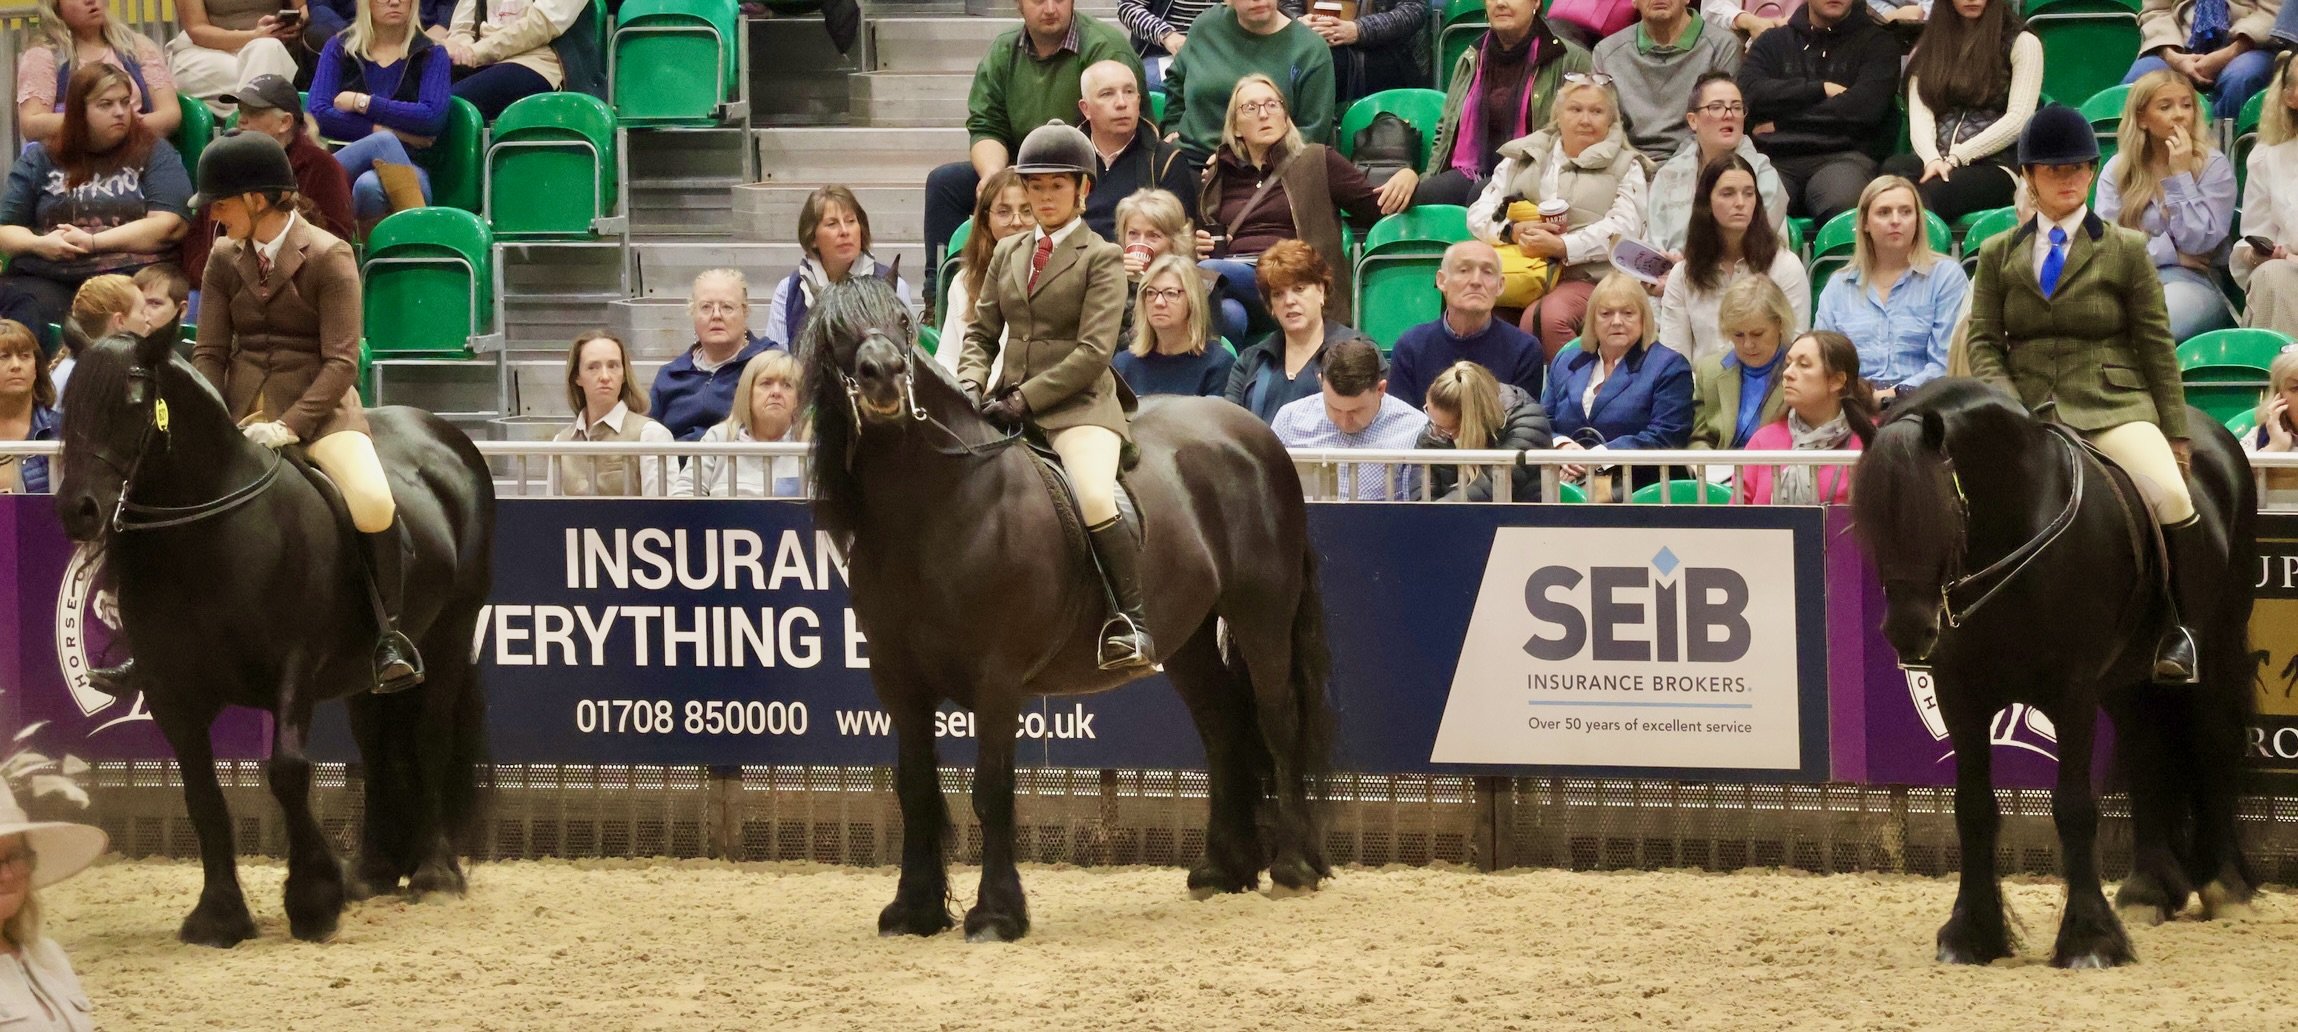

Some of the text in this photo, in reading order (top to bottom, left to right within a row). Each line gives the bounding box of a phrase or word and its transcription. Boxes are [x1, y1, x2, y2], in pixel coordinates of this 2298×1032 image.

[565, 527, 854, 591] INSURAN
[65, 598, 87, 688] HORSE
[470, 604, 871, 669] VERYTHING E
[1527, 674, 1644, 691] INSURANCE
[1917, 676, 1937, 710] HO
[576, 699, 675, 734] 01708
[684, 700, 808, 736] 850000
[1528, 717, 1753, 734] Over 50 years of excellent service
